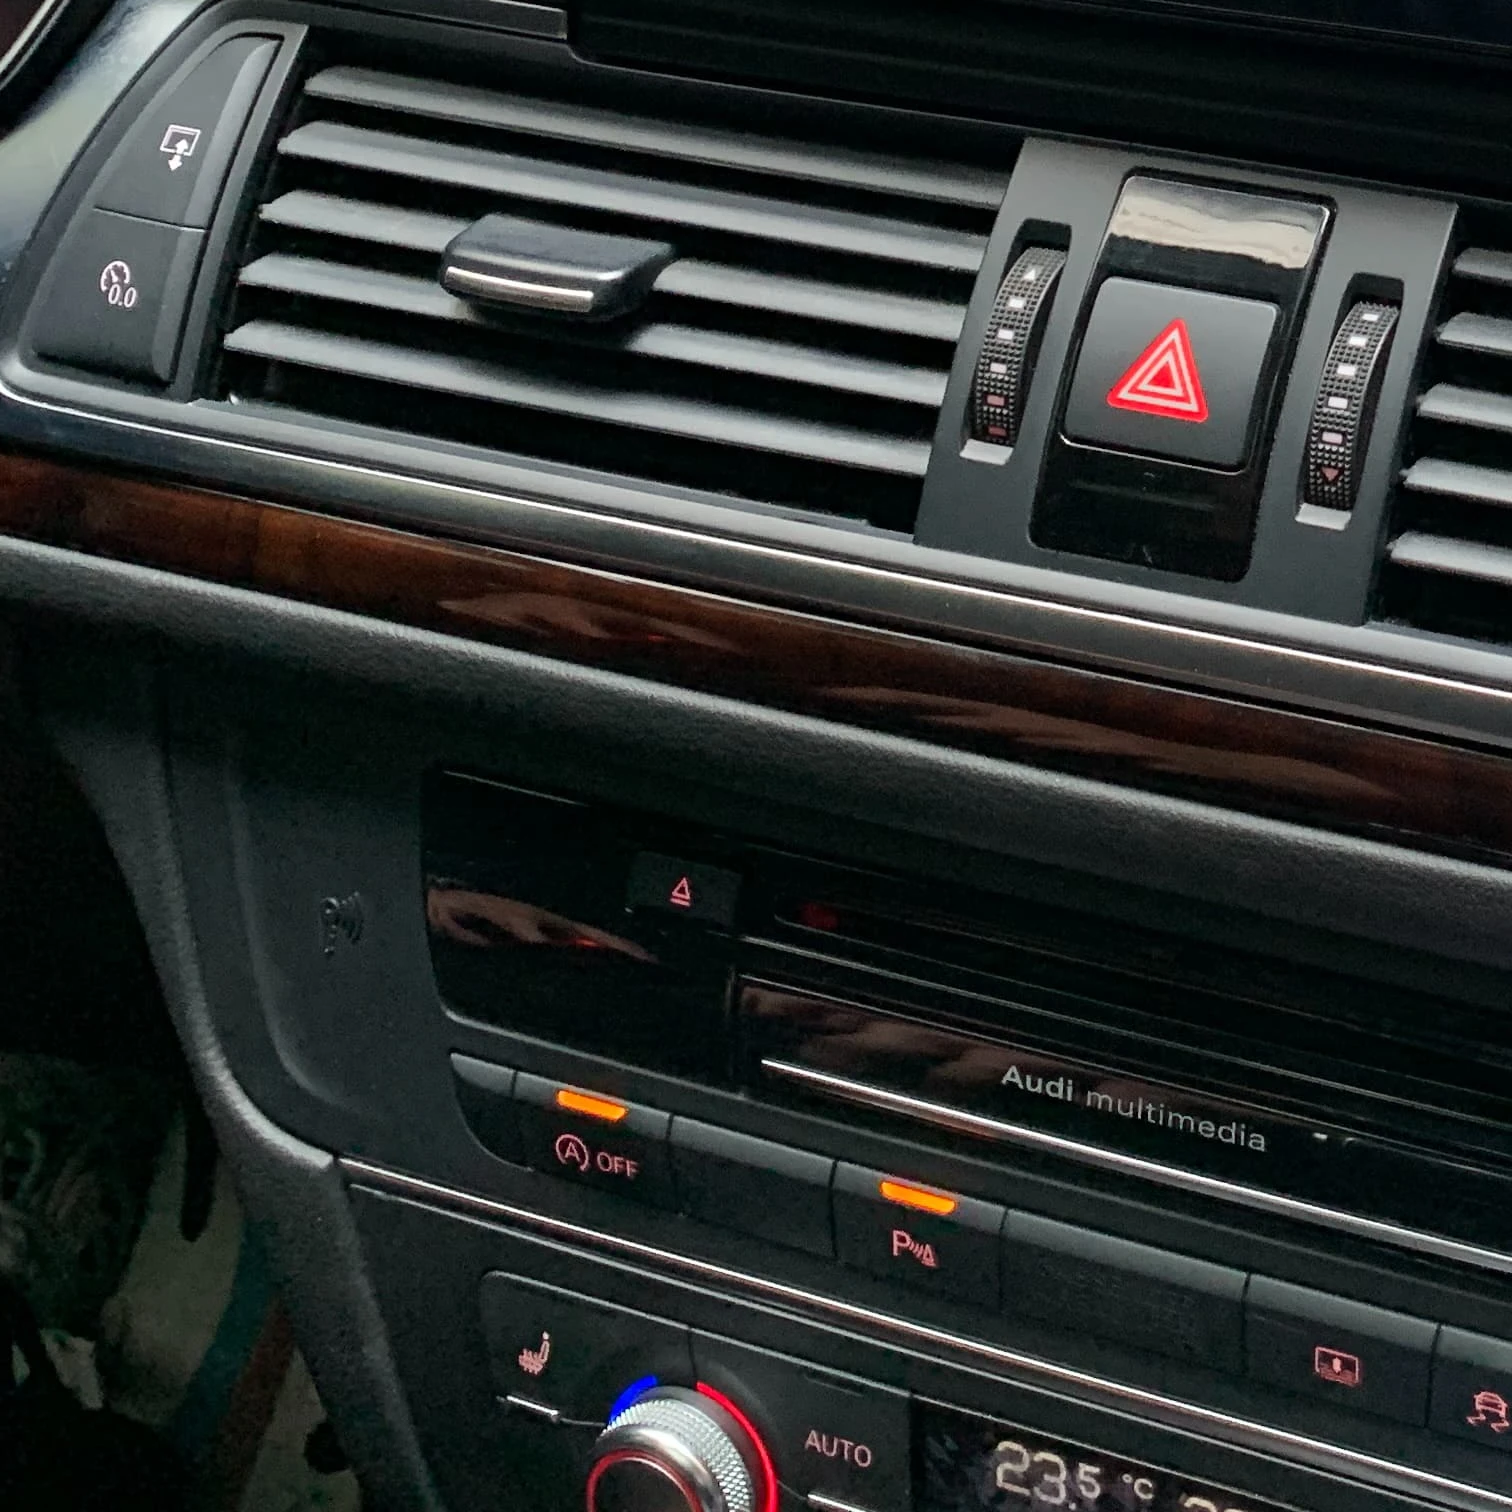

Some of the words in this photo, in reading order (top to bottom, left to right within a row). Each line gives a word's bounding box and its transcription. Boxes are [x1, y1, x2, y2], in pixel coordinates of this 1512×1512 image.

[107, 284, 138, 308] 0.0
[1001, 1064, 1074, 1103] Audi
[1086, 1088, 1267, 1153] multimedia
[596, 1150, 640, 1180] OFF
[804, 1429, 873, 1469] AUTO
